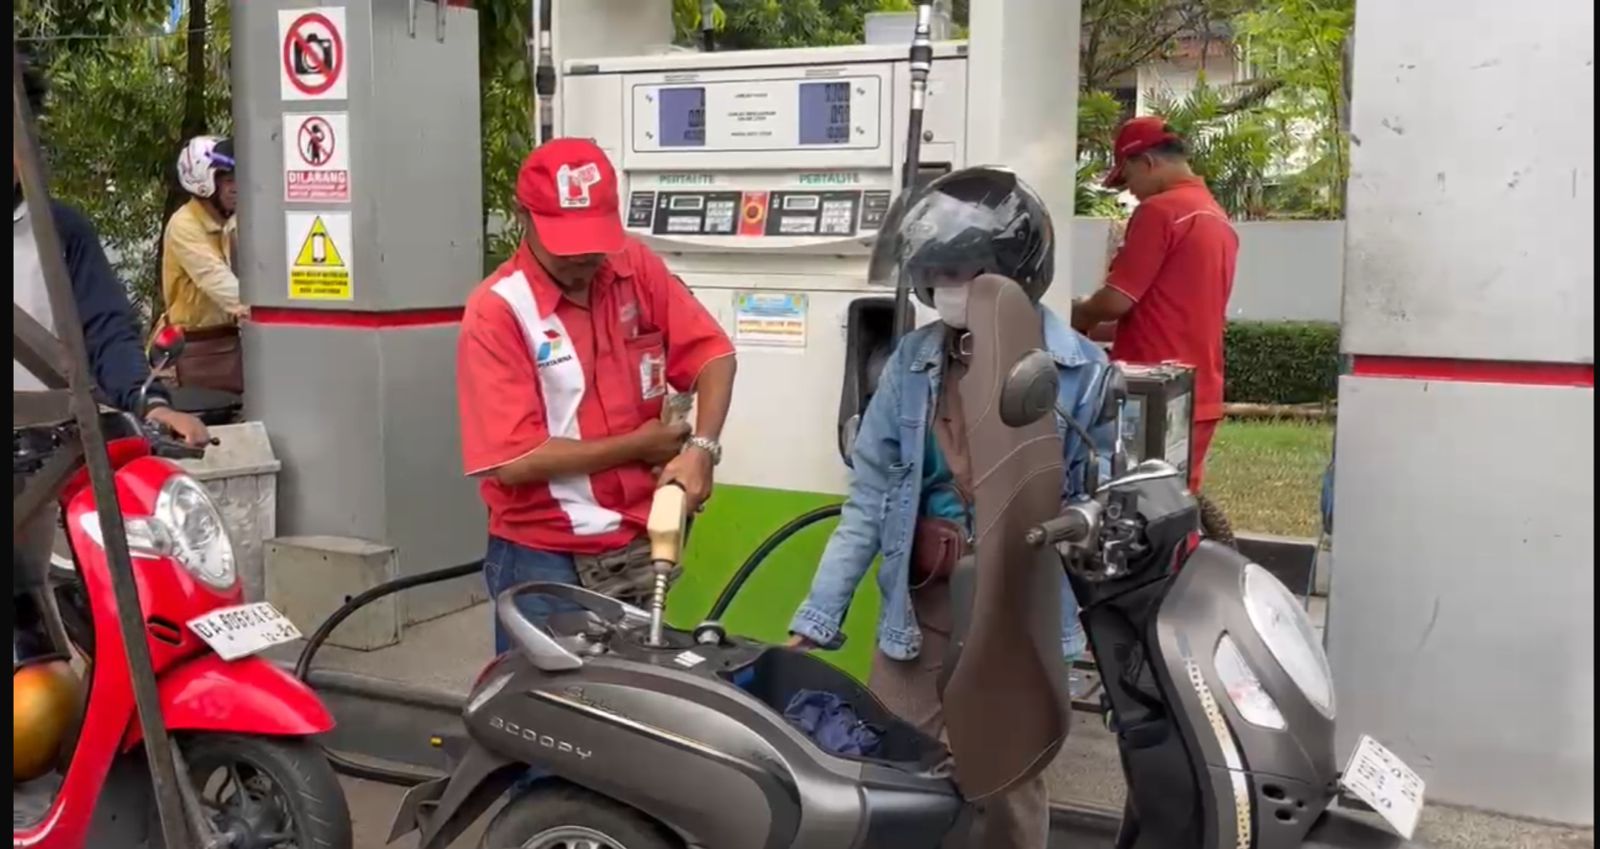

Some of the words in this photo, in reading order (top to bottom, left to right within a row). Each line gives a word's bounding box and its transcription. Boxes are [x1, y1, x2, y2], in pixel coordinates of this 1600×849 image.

[288, 171, 347, 184] DILARANG
[659, 174, 714, 185] PERTALITE
[799, 173, 860, 184] PERTALITE
[193, 616, 223, 639] DA
[489, 716, 593, 760] SCOOPY
